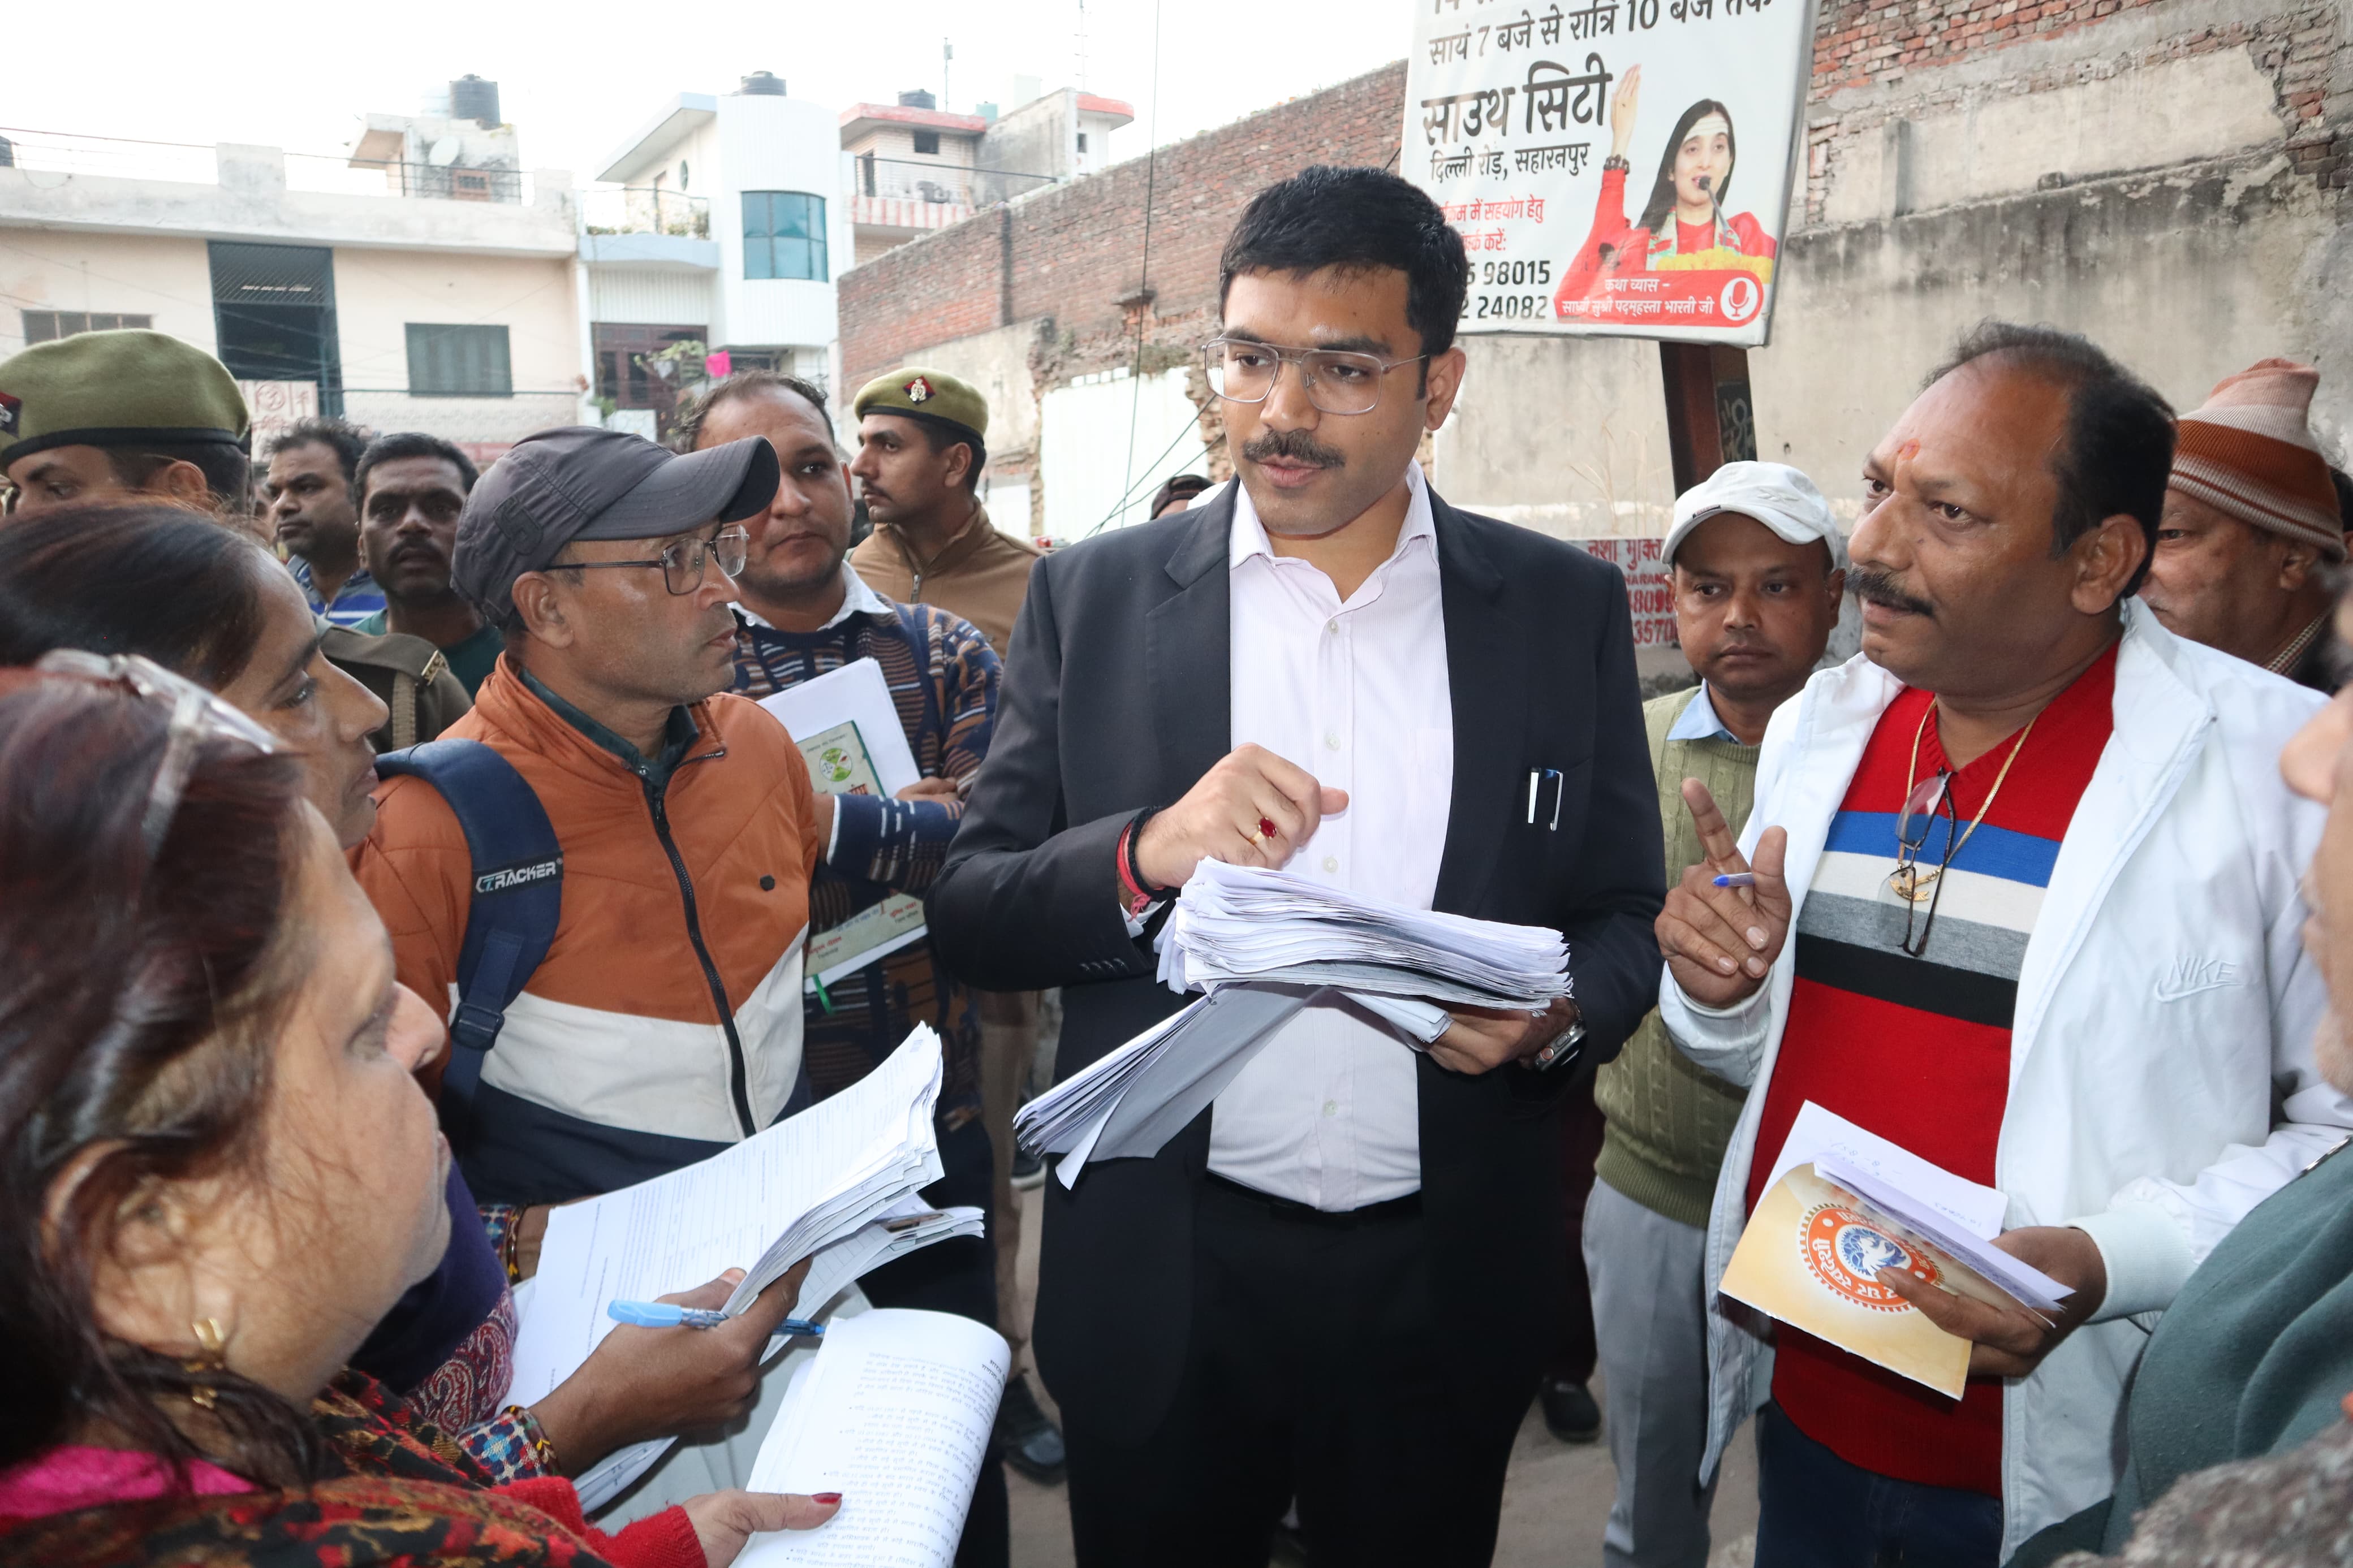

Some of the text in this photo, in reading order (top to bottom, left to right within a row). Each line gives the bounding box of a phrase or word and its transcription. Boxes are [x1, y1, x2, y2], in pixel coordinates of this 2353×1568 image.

[1429, 24, 1472, 65] सायं
[1477, 25, 1490, 57] 7
[1496, 10, 1535, 53] बजे
[1540, 8, 1565, 45] से
[1568, 1, 1619, 41] रात्रि
[1628, 0, 1659, 33] 10
[1421, 51, 1614, 146] साउथ सिटी
[1430, 145, 1475, 184] दिल्ली
[1515, 142, 1591, 177] सहारनपुर
[1469, 198, 1483, 221] में
[1484, 195, 1525, 221] सहयोग
[1527, 193, 1545, 224] हेतु
[1483, 260, 1552, 286] 98015
[1605, 278, 1628, 292] कथा
[1630, 278, 1661, 292] व्यास
[1477, 295, 1548, 320] 24082
[1665, 295, 1697, 314] भारती
[1698, 295, 1716, 314] जी
[2170, 955, 2236, 983] NIKE
[1812, 1237, 1853, 1291] स्वदेशी
